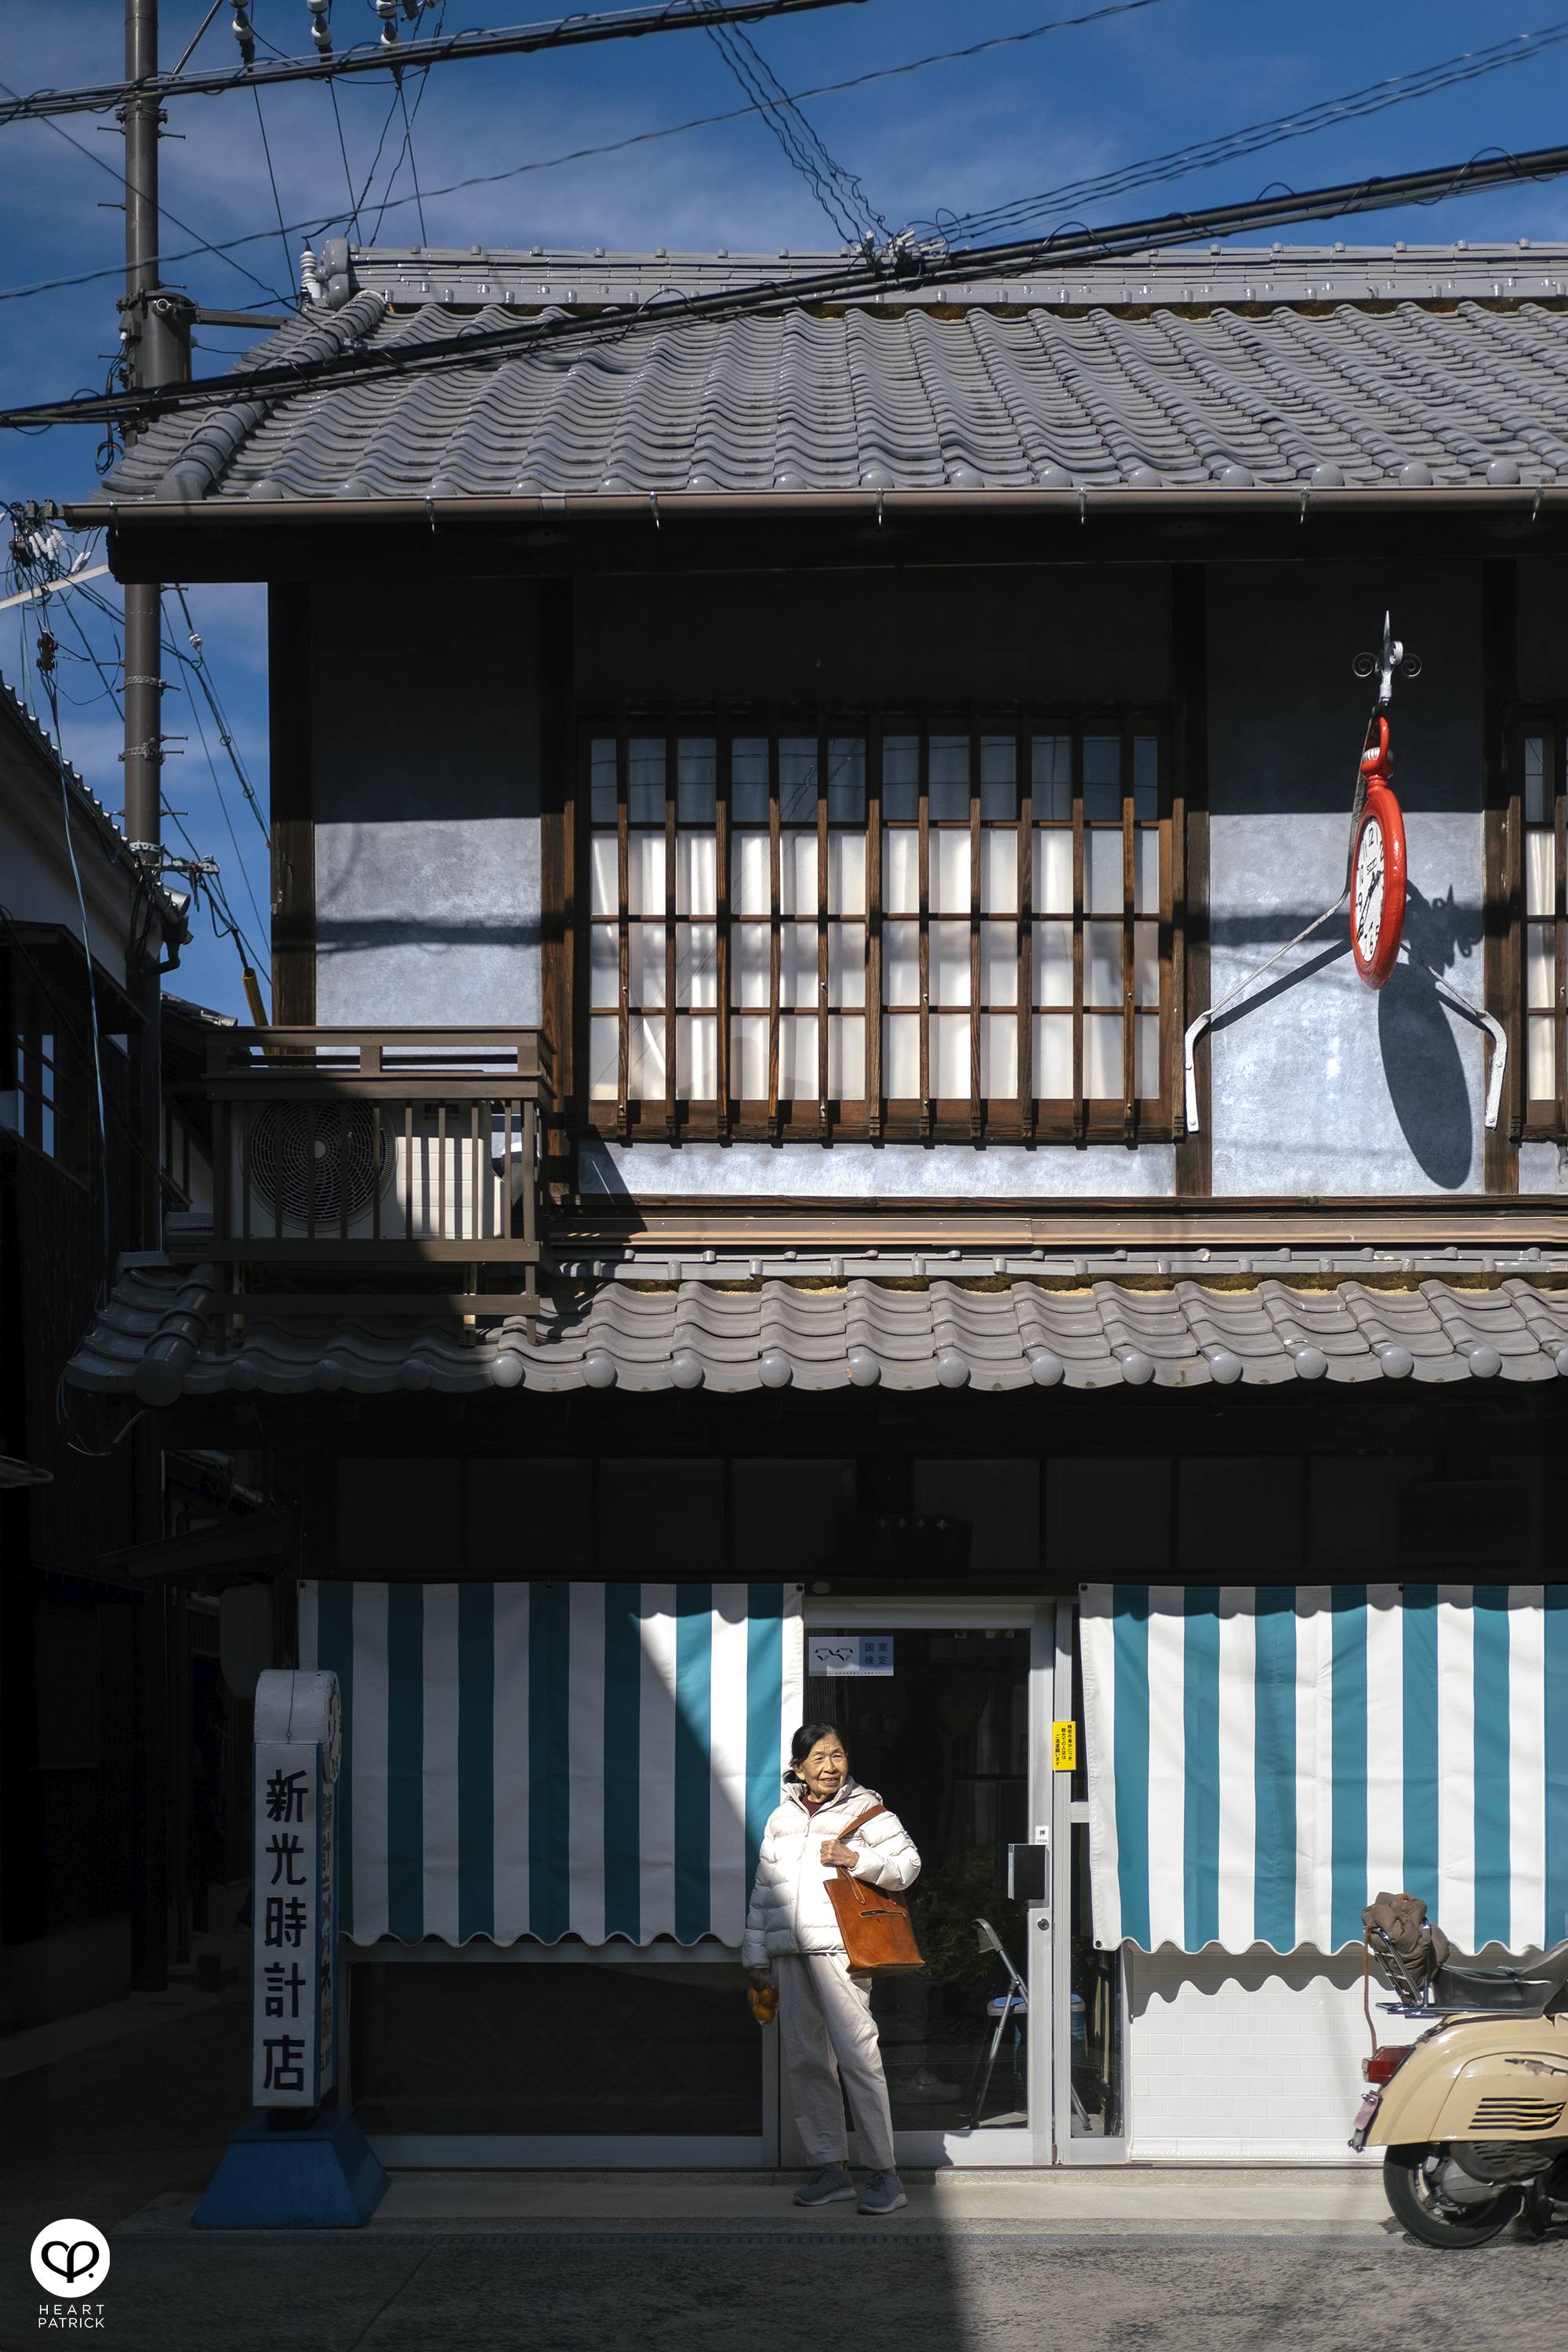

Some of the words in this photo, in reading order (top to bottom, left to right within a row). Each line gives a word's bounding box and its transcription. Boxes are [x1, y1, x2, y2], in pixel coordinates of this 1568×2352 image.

[865, 1642, 887, 1652] 国家
[865, 1656, 887, 1665] 検定
[263, 1769, 308, 2092] 新光時計店
